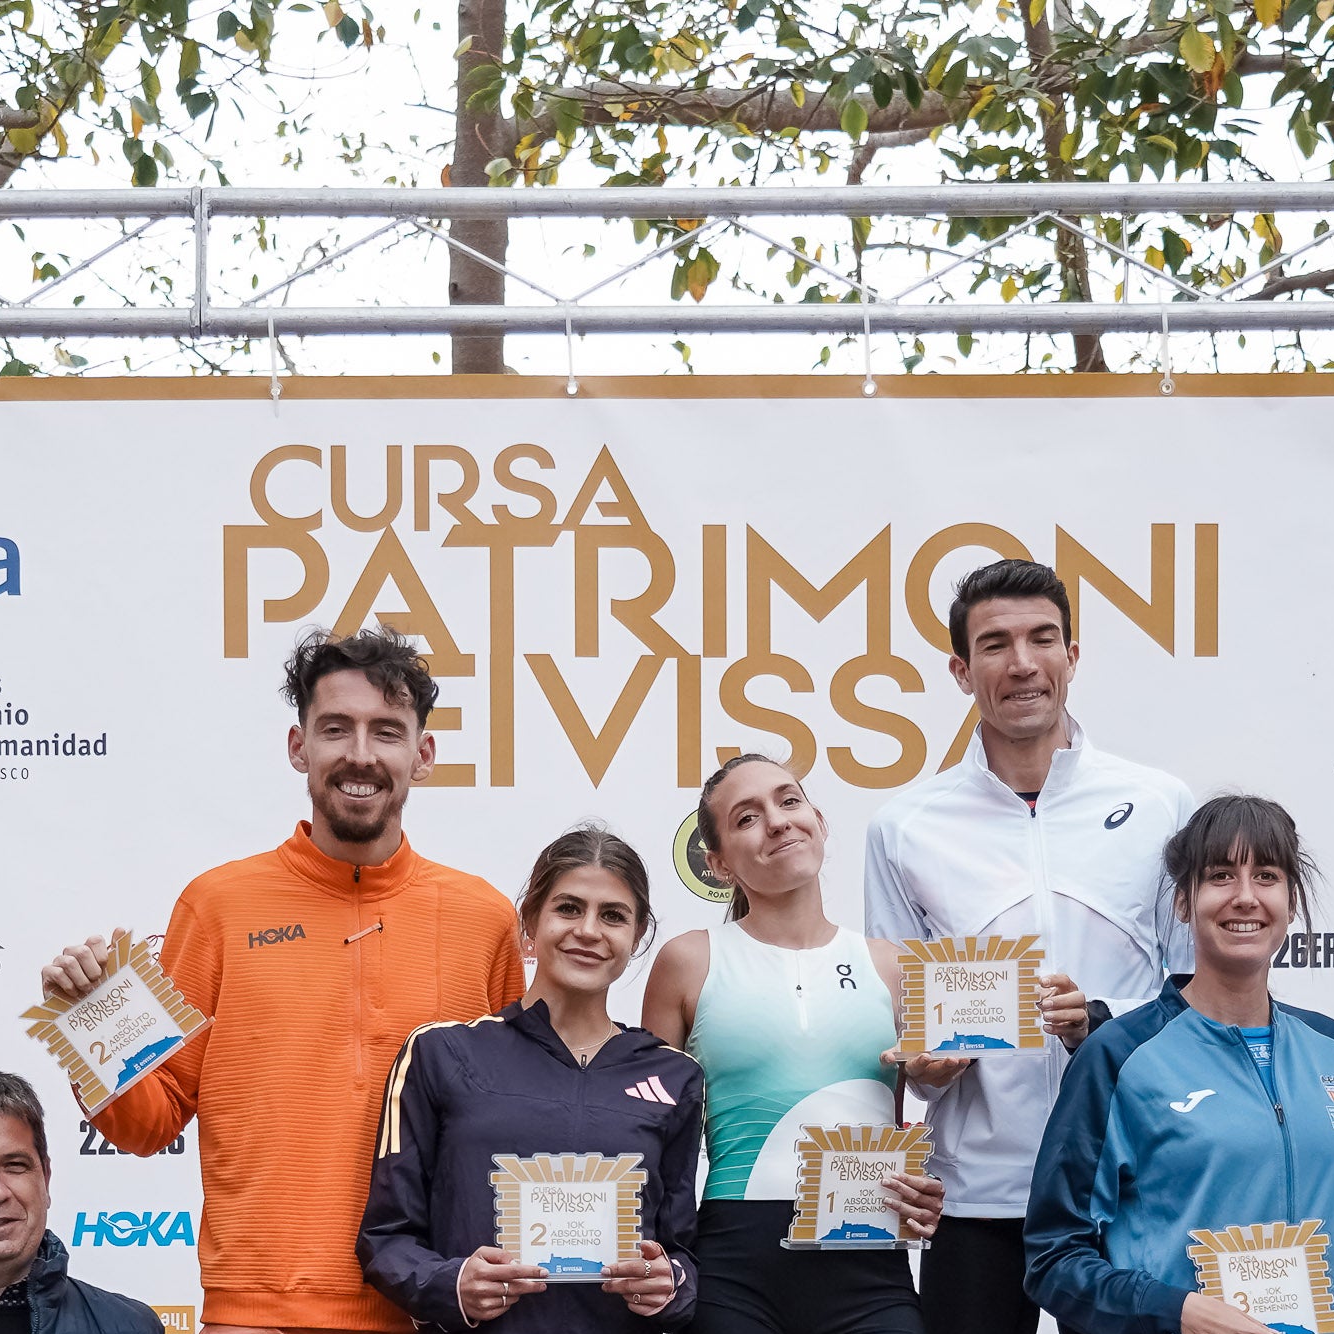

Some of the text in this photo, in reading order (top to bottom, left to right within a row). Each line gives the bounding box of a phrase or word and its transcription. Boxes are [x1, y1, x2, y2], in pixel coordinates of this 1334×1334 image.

[250, 444, 652, 533] CURSA
[223, 522, 1218, 660] PATRIMONI
[247, 923, 307, 949] HOKA
[934, 971, 1008, 983] PATRIMONI
[936, 967, 966, 975] CURSA
[946, 981, 997, 992] EIVISSA
[68, 979, 134, 1032] PATRIMONI
[970, 999, 987, 1007] 10K
[67, 1001, 96, 1022] CURSA
[84, 995, 131, 1033] EIVISSA
[953, 1007, 1004, 1016] ABSOLUTO
[116, 1014, 133, 1030] 10K
[951, 1015, 1006, 1025] MASCULINO
[109, 1012, 151, 1047] ABSOLUTO
[111, 1017, 157, 1056] MASCULINO
[830, 1161, 897, 1172] PATRIMONI
[839, 1171, 885, 1181] EIVISSA
[532, 1186, 564, 1195] CURSA
[859, 1189, 875, 1197] 10K
[530, 1192, 607, 1204] PATRIMONI
[542, 1202, 596, 1213] EIVISSA
[843, 1205, 887, 1214] FEMENINO
[71, 1211, 196, 1247] HOKA
[567, 1221, 585, 1229] 10K
[550, 1229, 602, 1238] ABSOLUTO
[551, 1238, 601, 1246] FEMENINO
[1228, 1257, 1298, 1273] PATRIMONI
[1241, 1268, 1289, 1282] EIVISSA
[1252, 1293, 1298, 1305] ABSOLUTO
[1253, 1302, 1299, 1314] FEMENINO
